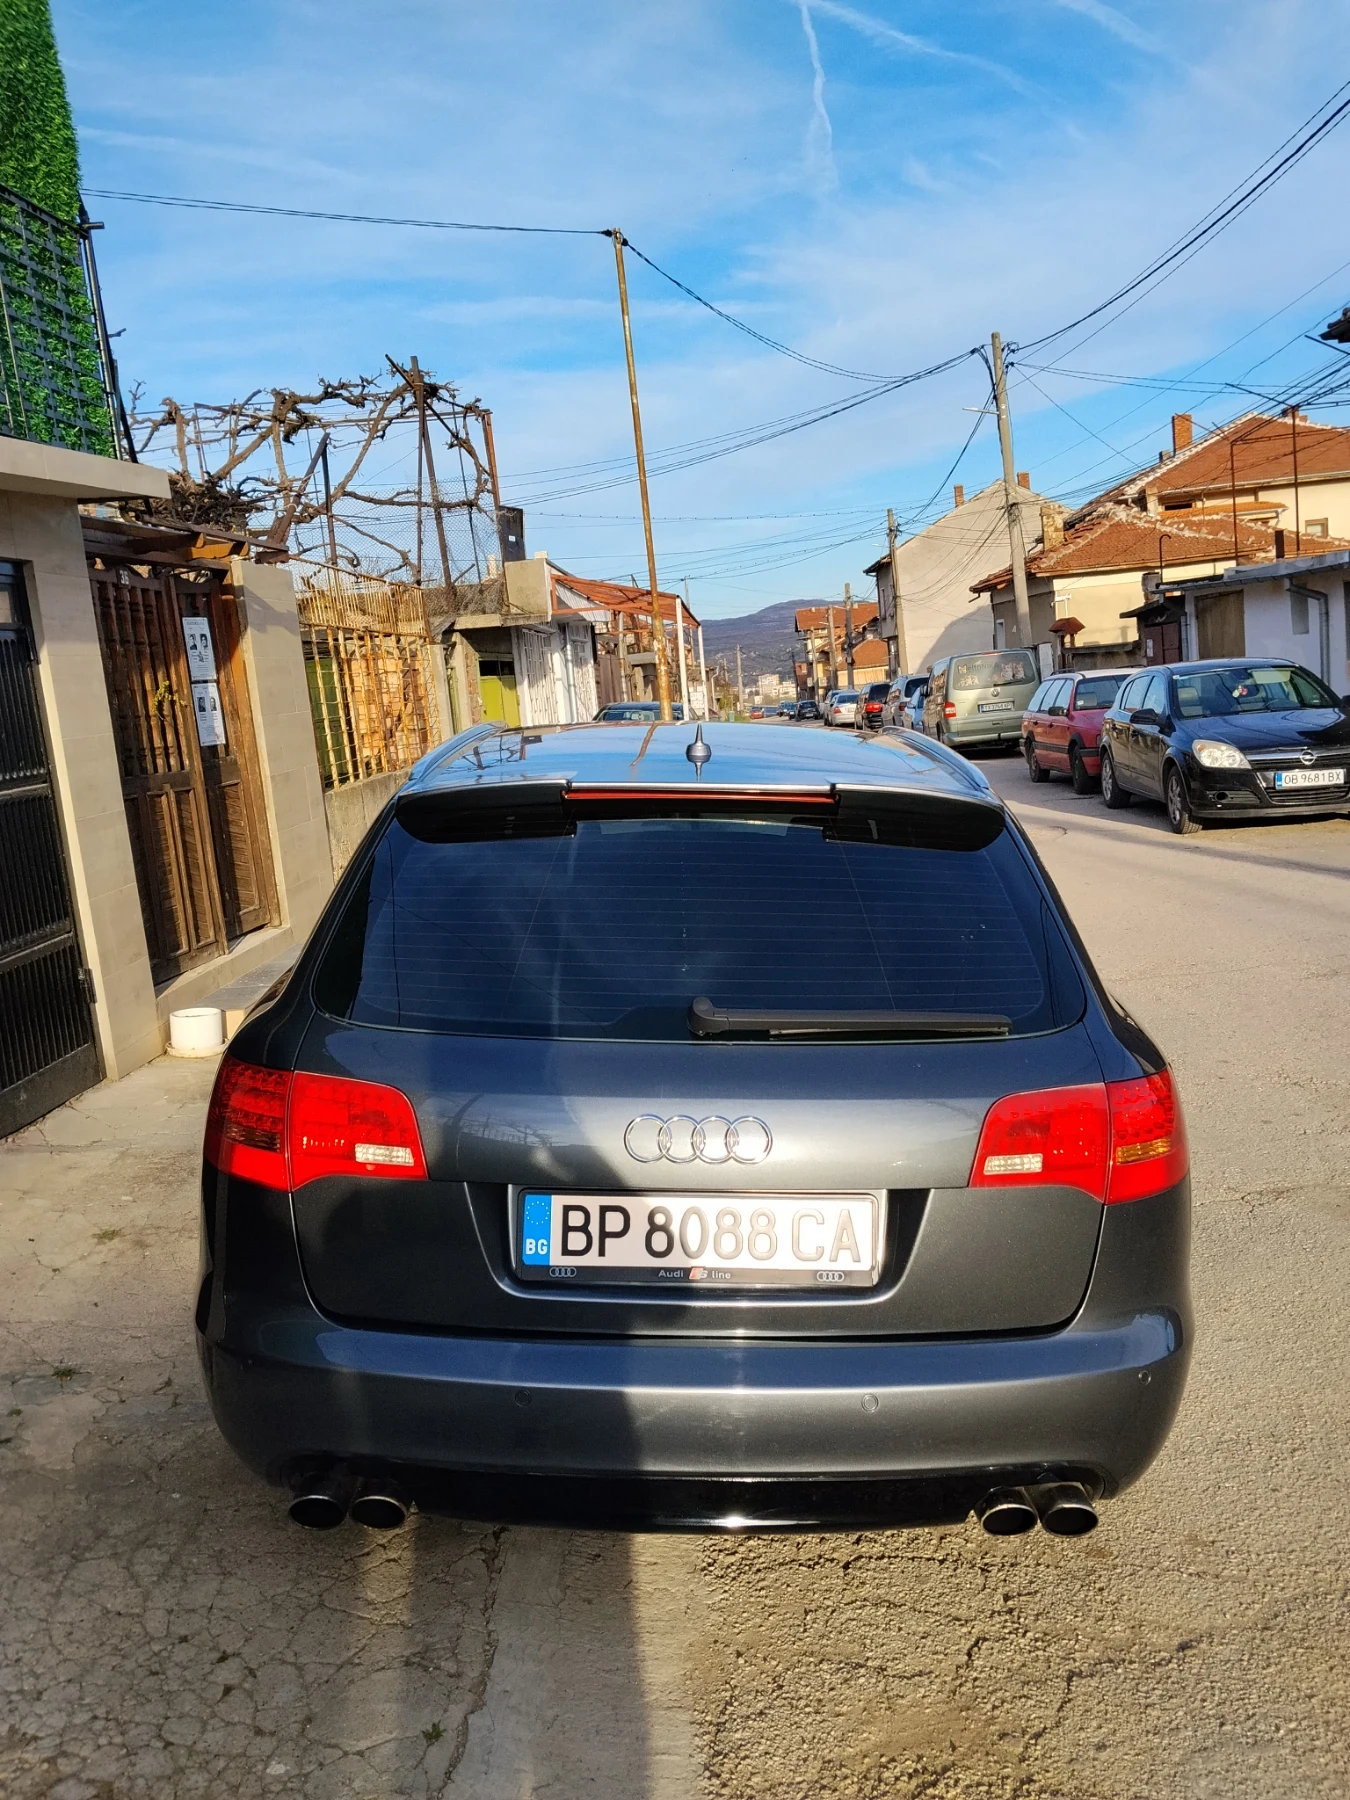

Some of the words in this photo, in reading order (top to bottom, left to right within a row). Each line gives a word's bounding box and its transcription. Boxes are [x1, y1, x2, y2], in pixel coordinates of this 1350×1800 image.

[1284, 774, 1299, 785] OB
[1300, 773, 1326, 784] 9681
[1328, 772, 1341, 783] BX
[561, 1204, 631, 1257] BP
[645, 1205, 778, 1261] 8088
[792, 1208, 861, 1262] CA
[525, 1238, 548, 1255] BG
[658, 1270, 684, 1278] Audi
[712, 1270, 731, 1279] line
